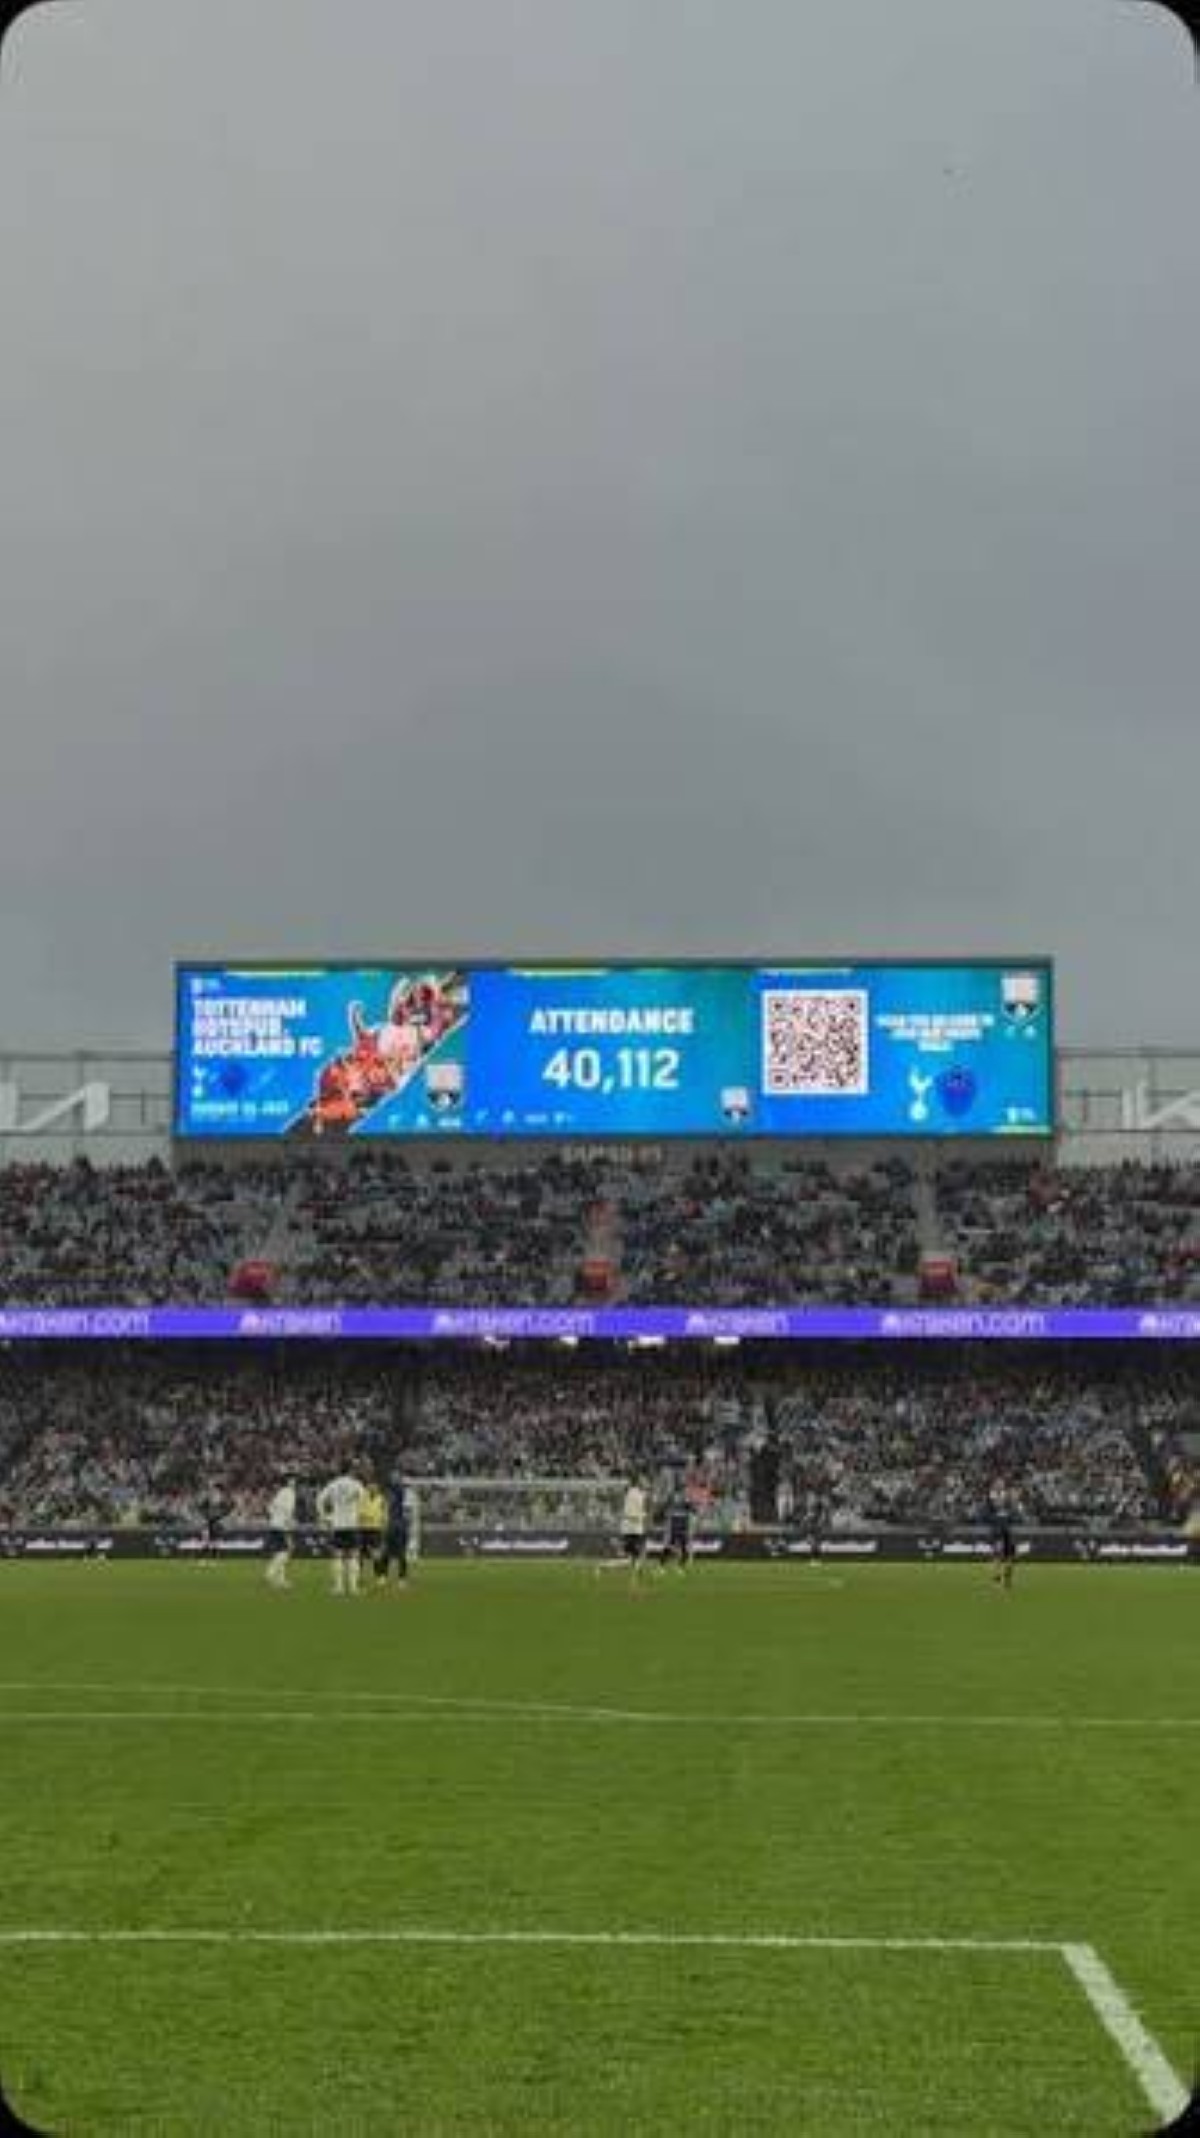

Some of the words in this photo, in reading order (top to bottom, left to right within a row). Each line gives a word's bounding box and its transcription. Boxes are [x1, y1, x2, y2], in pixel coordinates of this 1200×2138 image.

[529, 1007, 694, 1034] ATTENDANCE
[298, 1037, 323, 1057] FC
[541, 1047, 680, 1095] 40,112
